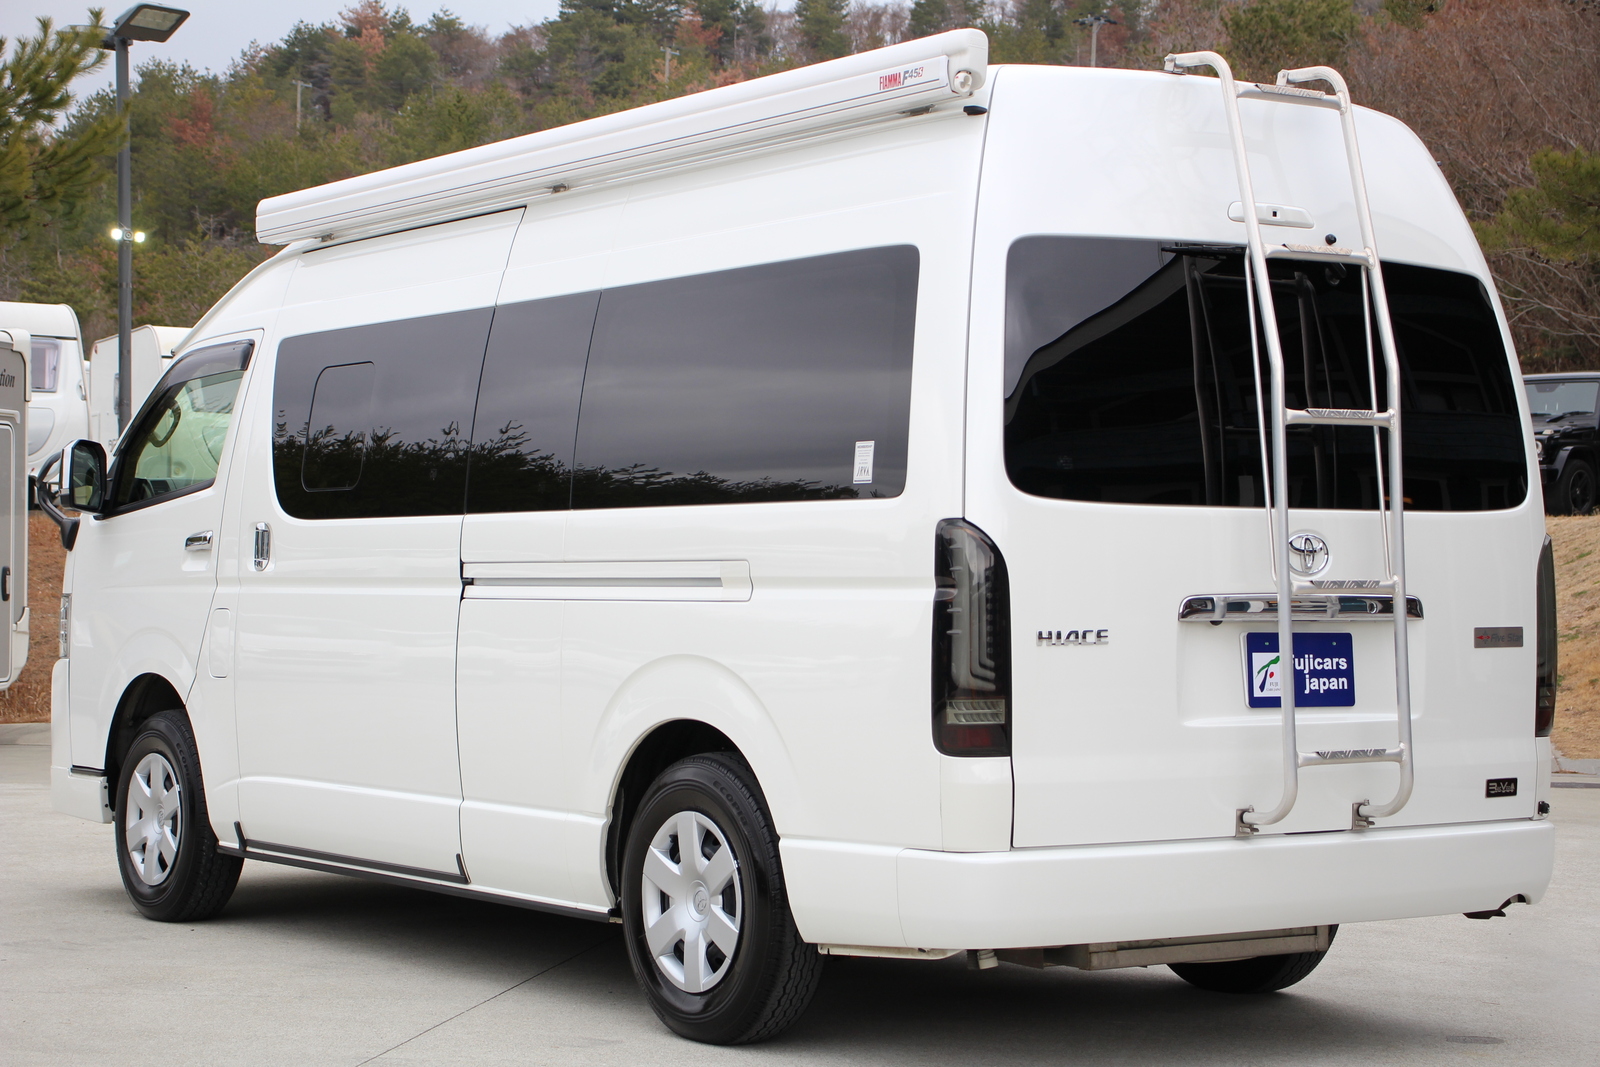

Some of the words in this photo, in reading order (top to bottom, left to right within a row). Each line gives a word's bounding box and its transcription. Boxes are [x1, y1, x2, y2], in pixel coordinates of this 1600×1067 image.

[879, 72, 902, 91] FIAMMA
[1037, 629, 1109, 646] HIACE
[1292, 654, 1348, 674] ujicars
[1304, 674, 1348, 694] japan
